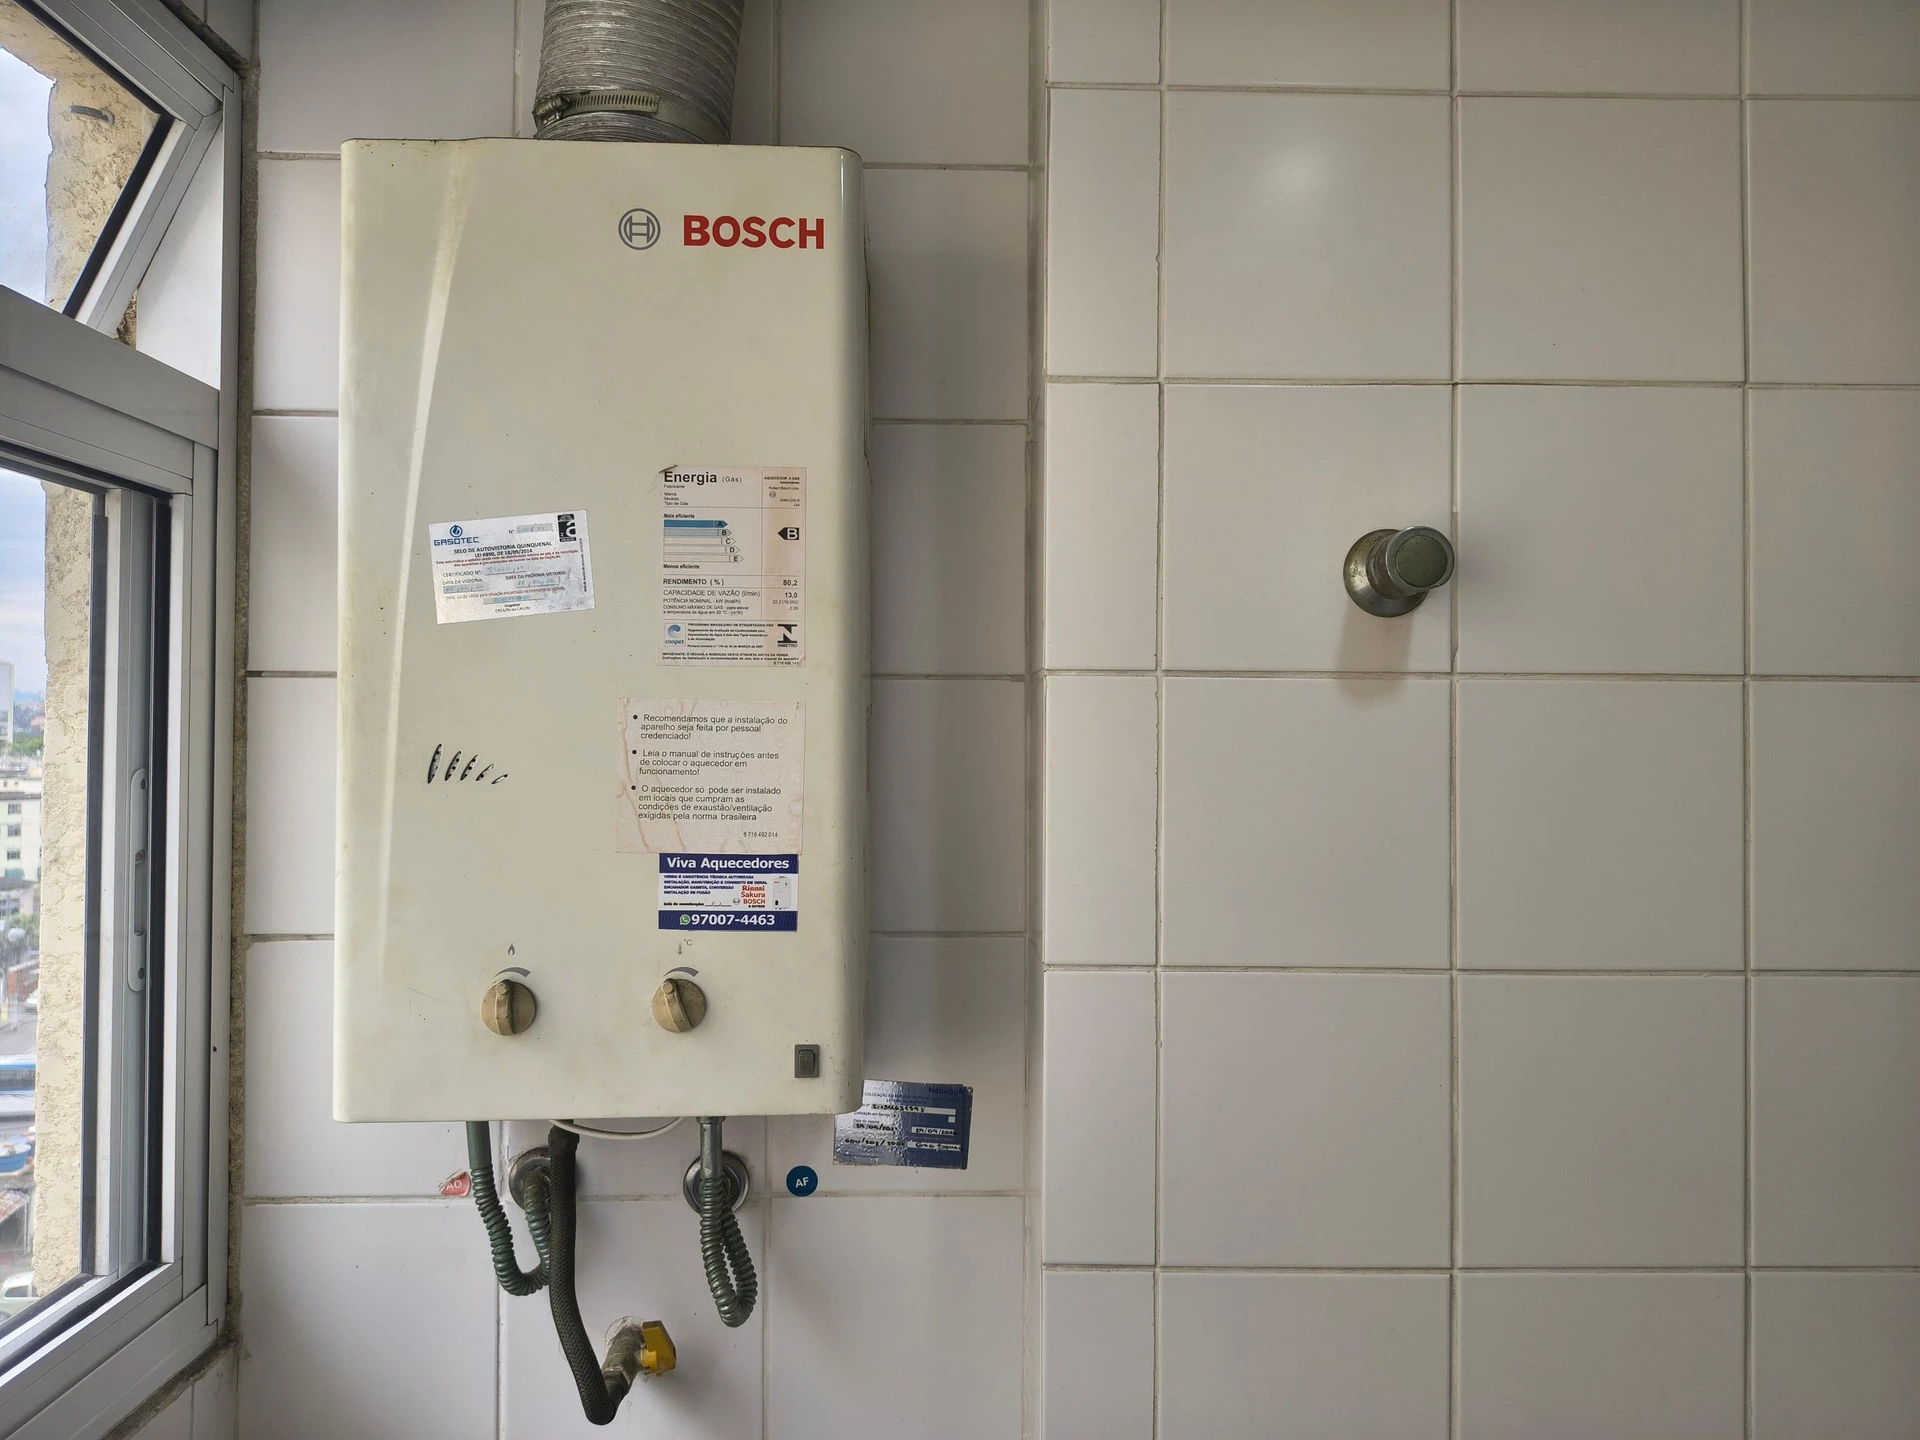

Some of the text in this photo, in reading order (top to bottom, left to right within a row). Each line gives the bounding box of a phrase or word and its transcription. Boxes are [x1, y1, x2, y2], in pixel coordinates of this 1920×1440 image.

[683, 214, 824, 250] BOSCH
[664, 471, 717, 485] Energia
[788, 528, 798, 539] B
[434, 537, 479, 546] GASOTEC
[644, 714, 707, 723] Recomendamos
[710, 716, 725, 725] que
[735, 716, 775, 725] instalação
[641, 723, 761, 734] aparelho seja feita por pessoal
[713, 751, 755, 759] instruções
[690, 759, 733, 768] aquecedor
[651, 785, 692, 794] aquecedor
[708, 786, 728, 795] pode
[638, 803, 678, 812] condições
[694, 804, 772, 813] exaustão/ventilação
[638, 812, 670, 820] exigidas
[673, 813, 689, 821] pela
[667, 857, 789, 870] Viva Aquecedores
[692, 914, 775, 925] 97007-4463
[447, 1180, 462, 1190] AQ
[795, 1177, 809, 1188] AF
